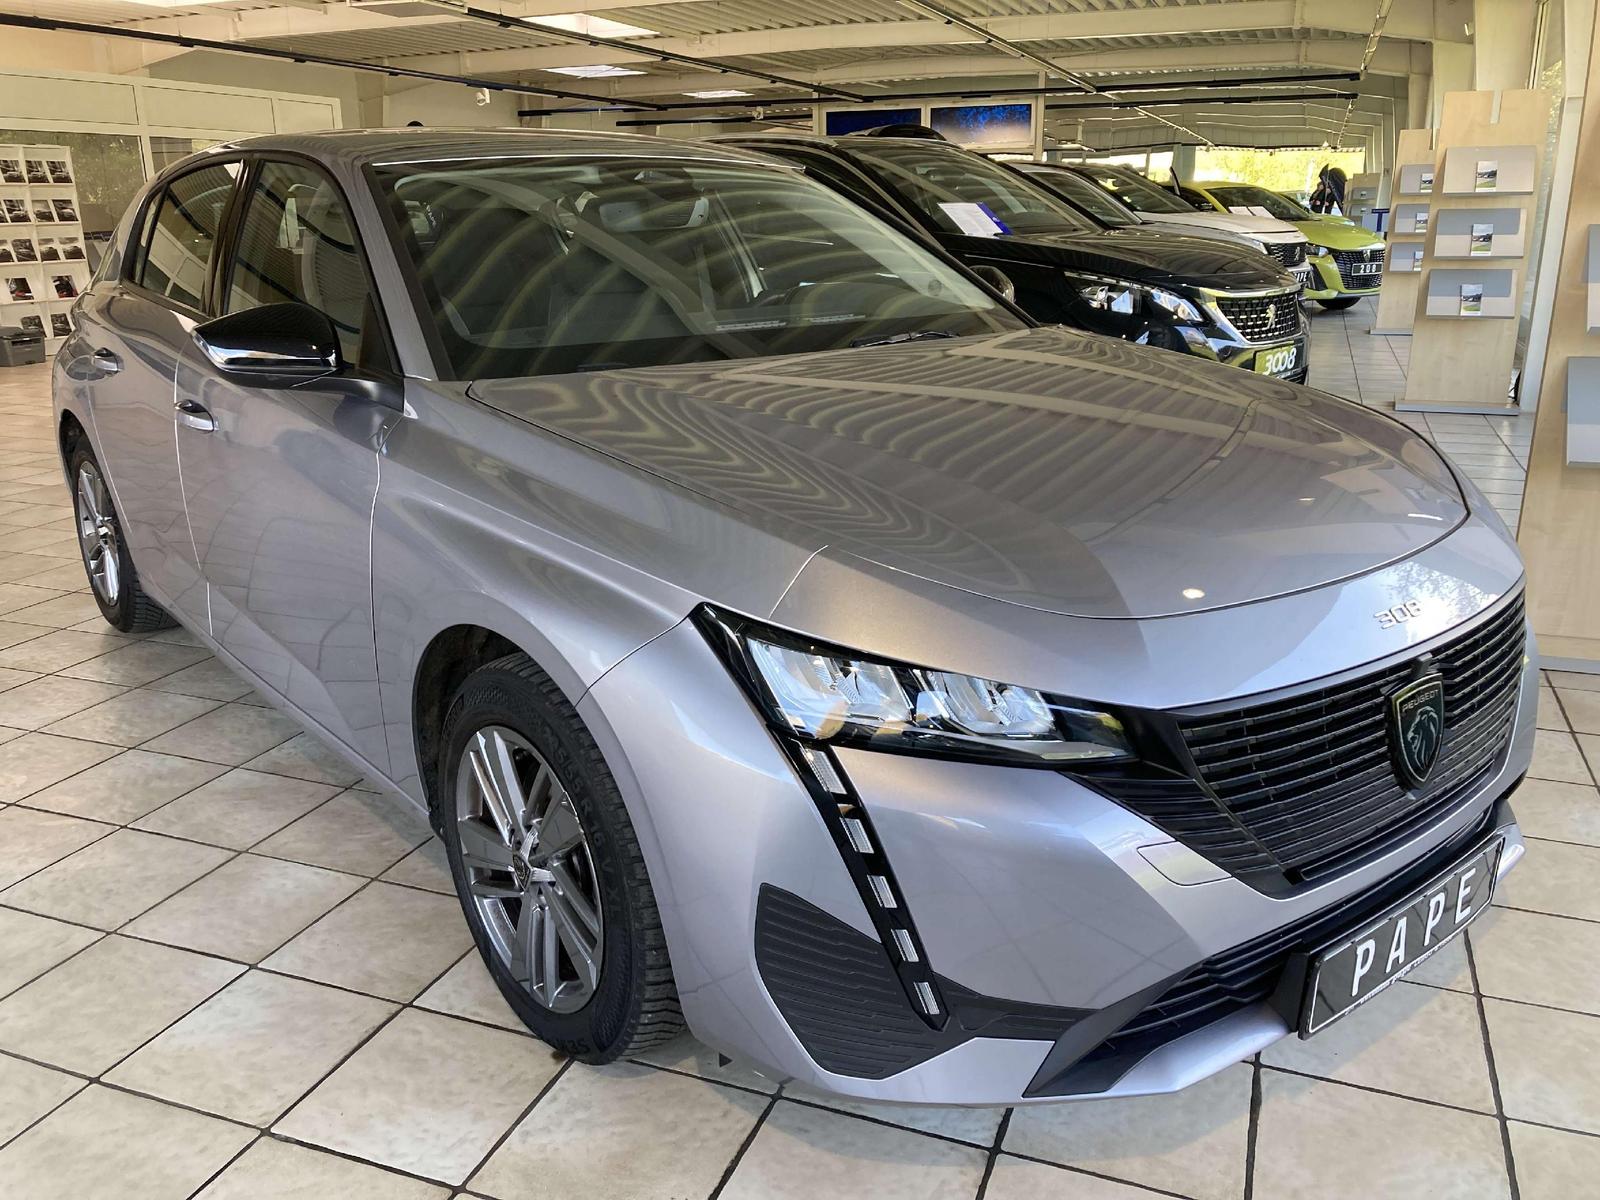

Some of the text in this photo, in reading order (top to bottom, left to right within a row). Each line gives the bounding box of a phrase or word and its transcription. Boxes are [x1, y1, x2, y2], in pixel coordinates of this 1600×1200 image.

[1360, 263, 1377, 273] 208
[1263, 347, 1297, 376] 3008
[1373, 600, 1422, 630] 308
[1402, 689, 1439, 713] PEUGEOT
[1351, 867, 1476, 997] PAPE
